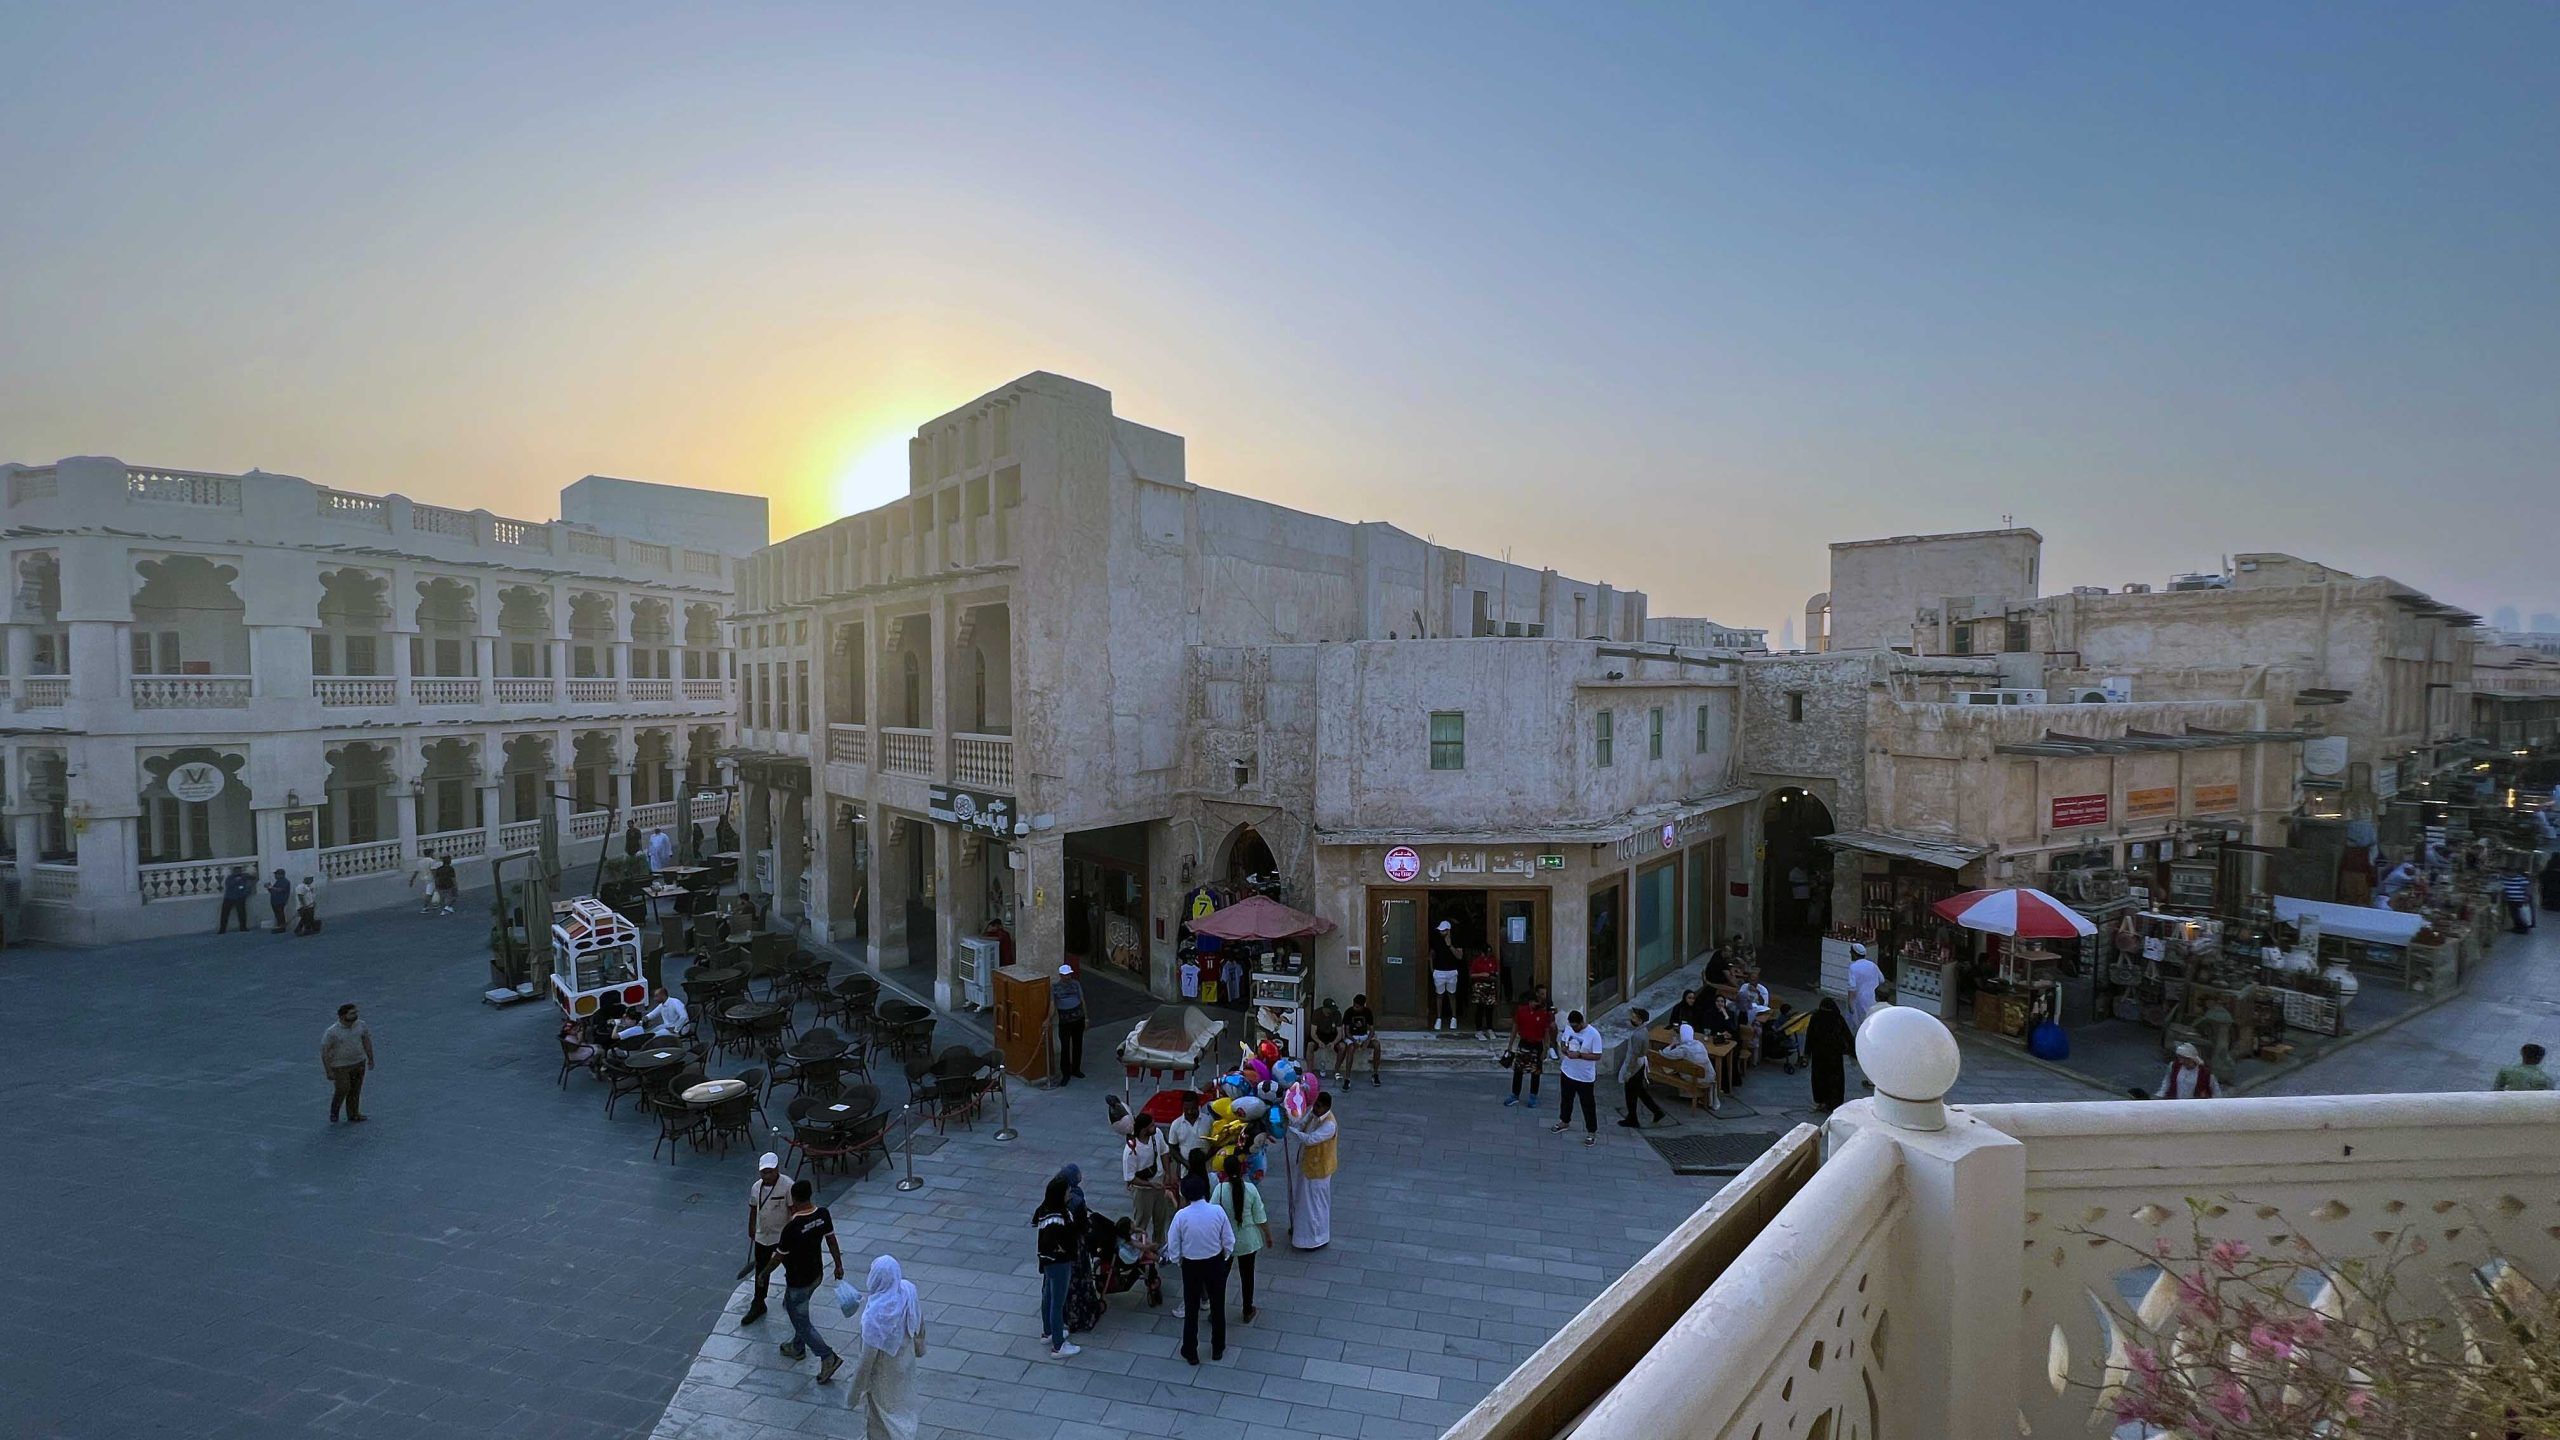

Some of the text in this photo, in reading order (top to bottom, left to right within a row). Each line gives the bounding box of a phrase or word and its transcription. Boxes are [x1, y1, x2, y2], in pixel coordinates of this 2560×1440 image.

[1428, 851, 1535, 882] وقت الشاي
[1199, 902, 1208, 916] 7
[1207, 959, 1213, 969] 11
[1187, 976, 1192, 987] 7
[1206, 986, 1212, 995] 7
